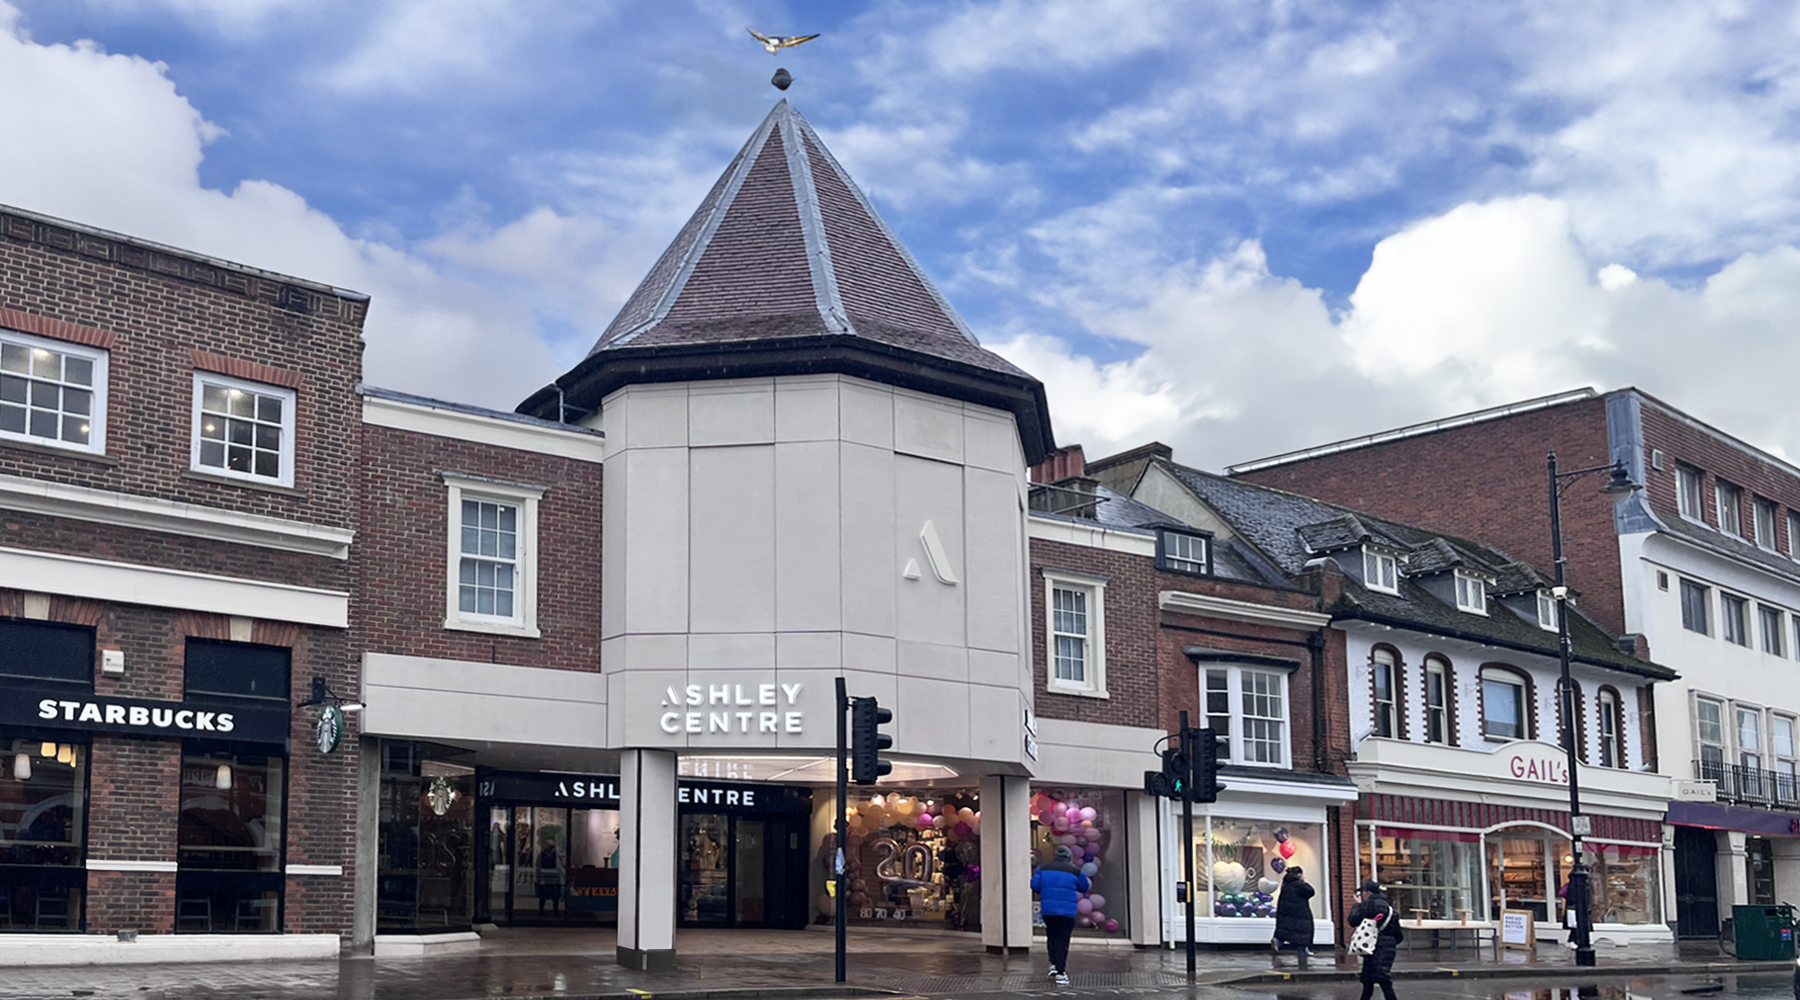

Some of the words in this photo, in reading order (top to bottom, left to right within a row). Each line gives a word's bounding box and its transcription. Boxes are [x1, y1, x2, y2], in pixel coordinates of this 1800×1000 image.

[661, 683, 803, 706] ASHLEY
[39, 699, 234, 732] STARBUCKS
[660, 712, 803, 734] CENTRE
[1510, 755, 1568, 783] GAIL's
[555, 781, 620, 799] ASHL
[678, 787, 754, 806] ENTRE
[1682, 788, 1711, 796] GAIL's
[870, 838, 933, 884] 20
